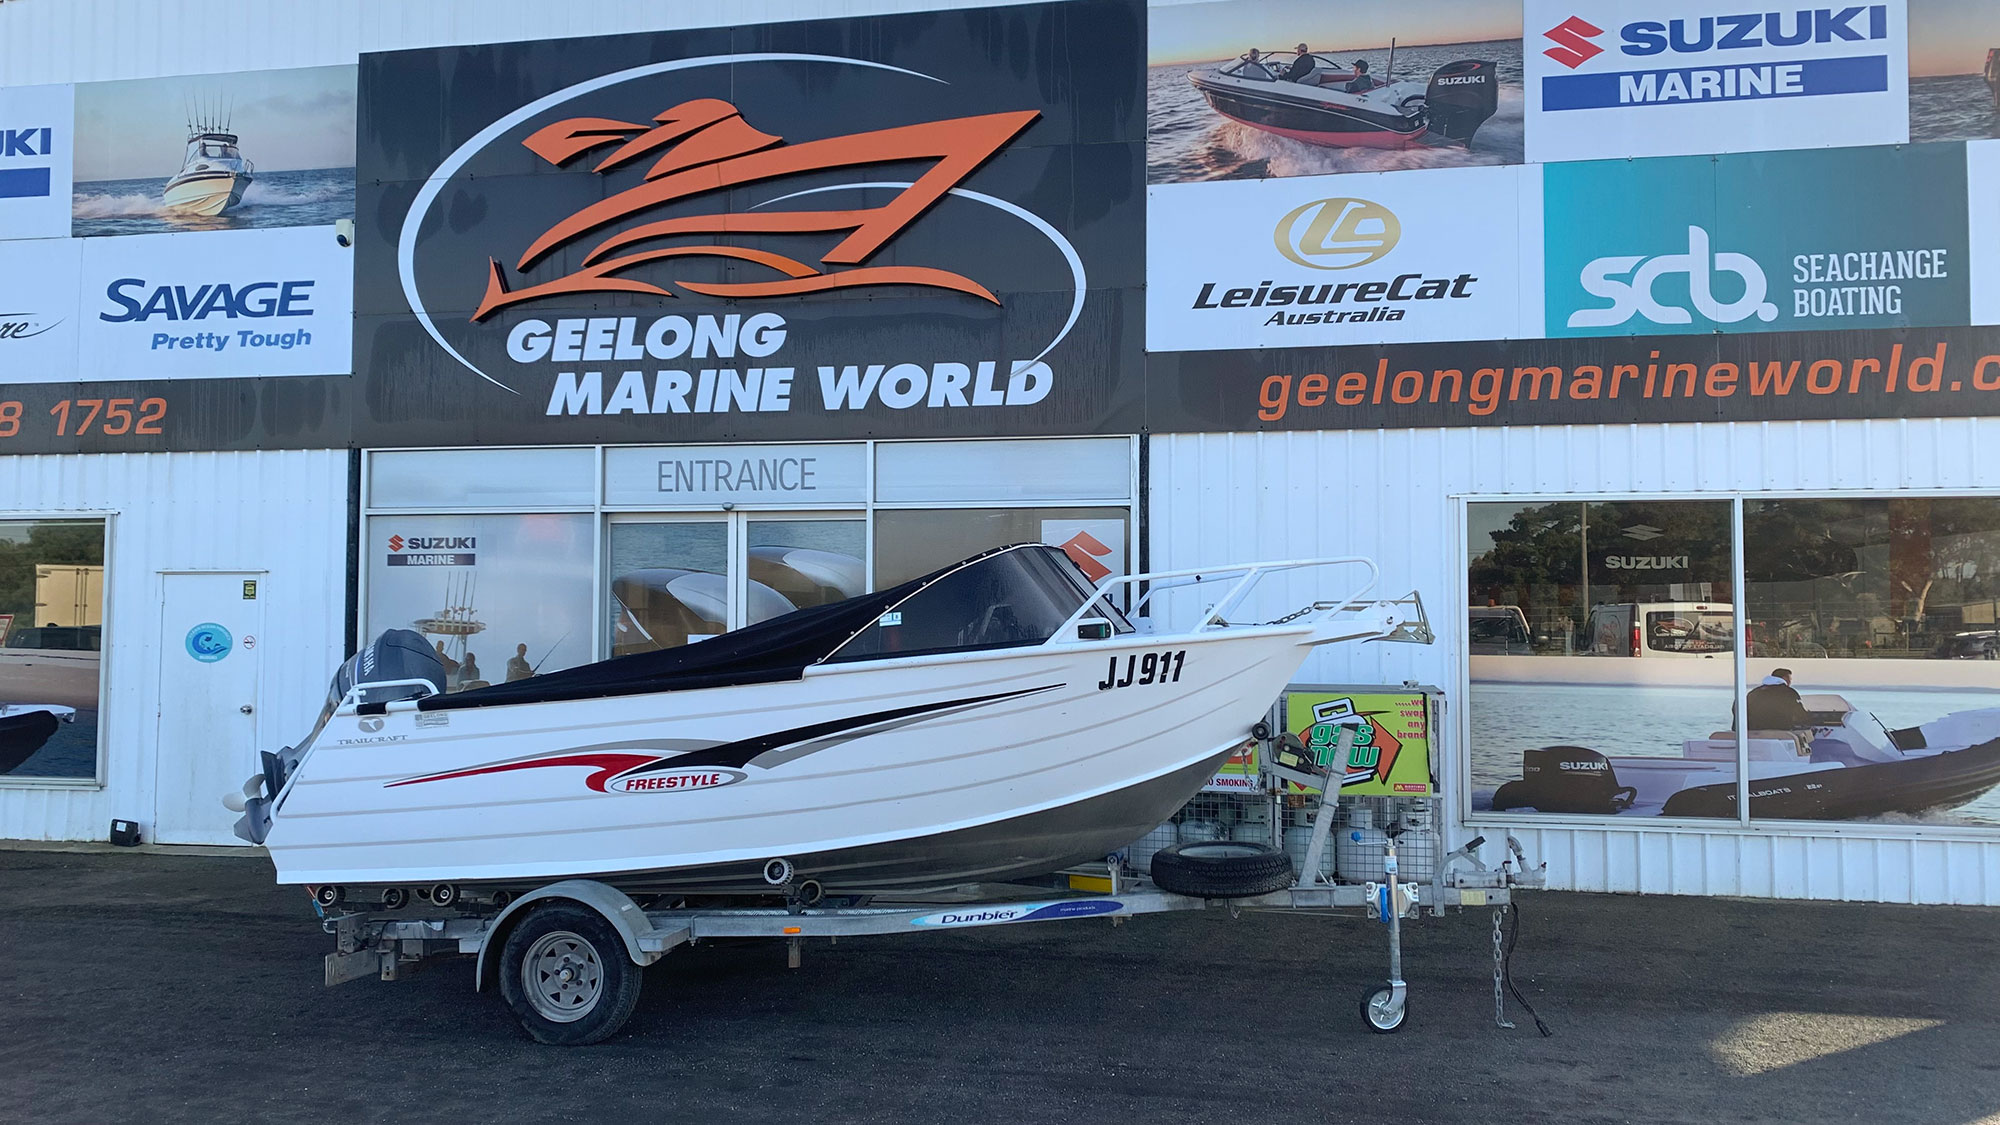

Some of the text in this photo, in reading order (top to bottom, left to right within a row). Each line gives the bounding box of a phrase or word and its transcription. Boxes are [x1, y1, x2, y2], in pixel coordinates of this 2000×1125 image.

[1620, 5, 1887, 56] SUZUKI
[1437, 74, 1486, 86] SUZUKI
[1619, 65, 1804, 104] MARINE
[1793, 249, 1947, 284] SEACHANGE
[100, 278, 315, 323] SAVAGE
[1192, 273, 1478, 310] LeisureCat
[1793, 285, 1902, 318] BOATING
[1263, 306, 1406, 327] Australia
[151, 329, 312, 352] Pretty Tough
[506, 312, 788, 363] GEELONG
[546, 360, 1054, 416] MARINE WORLD
[50, 397, 168, 437] 1752
[657, 457, 817, 494] ENTRANCE
[408, 536, 477, 550] SUZUKI
[406, 554, 455, 566] MARINE
[1605, 555, 1689, 570] SUZUKI
[1098, 650, 1186, 691] JJ911
[1400, 709, 1425, 719] swap
[1407, 720, 1426, 729] any
[337, 735, 408, 745] TRAILCRAFT
[1397, 730, 1426, 739] brand
[1310, 745, 1380, 767] nw
[1560, 761, 1608, 771] SUZUKI
[625, 773, 720, 791] FREESTYLE
[941, 909, 1019, 924] Dunbier
